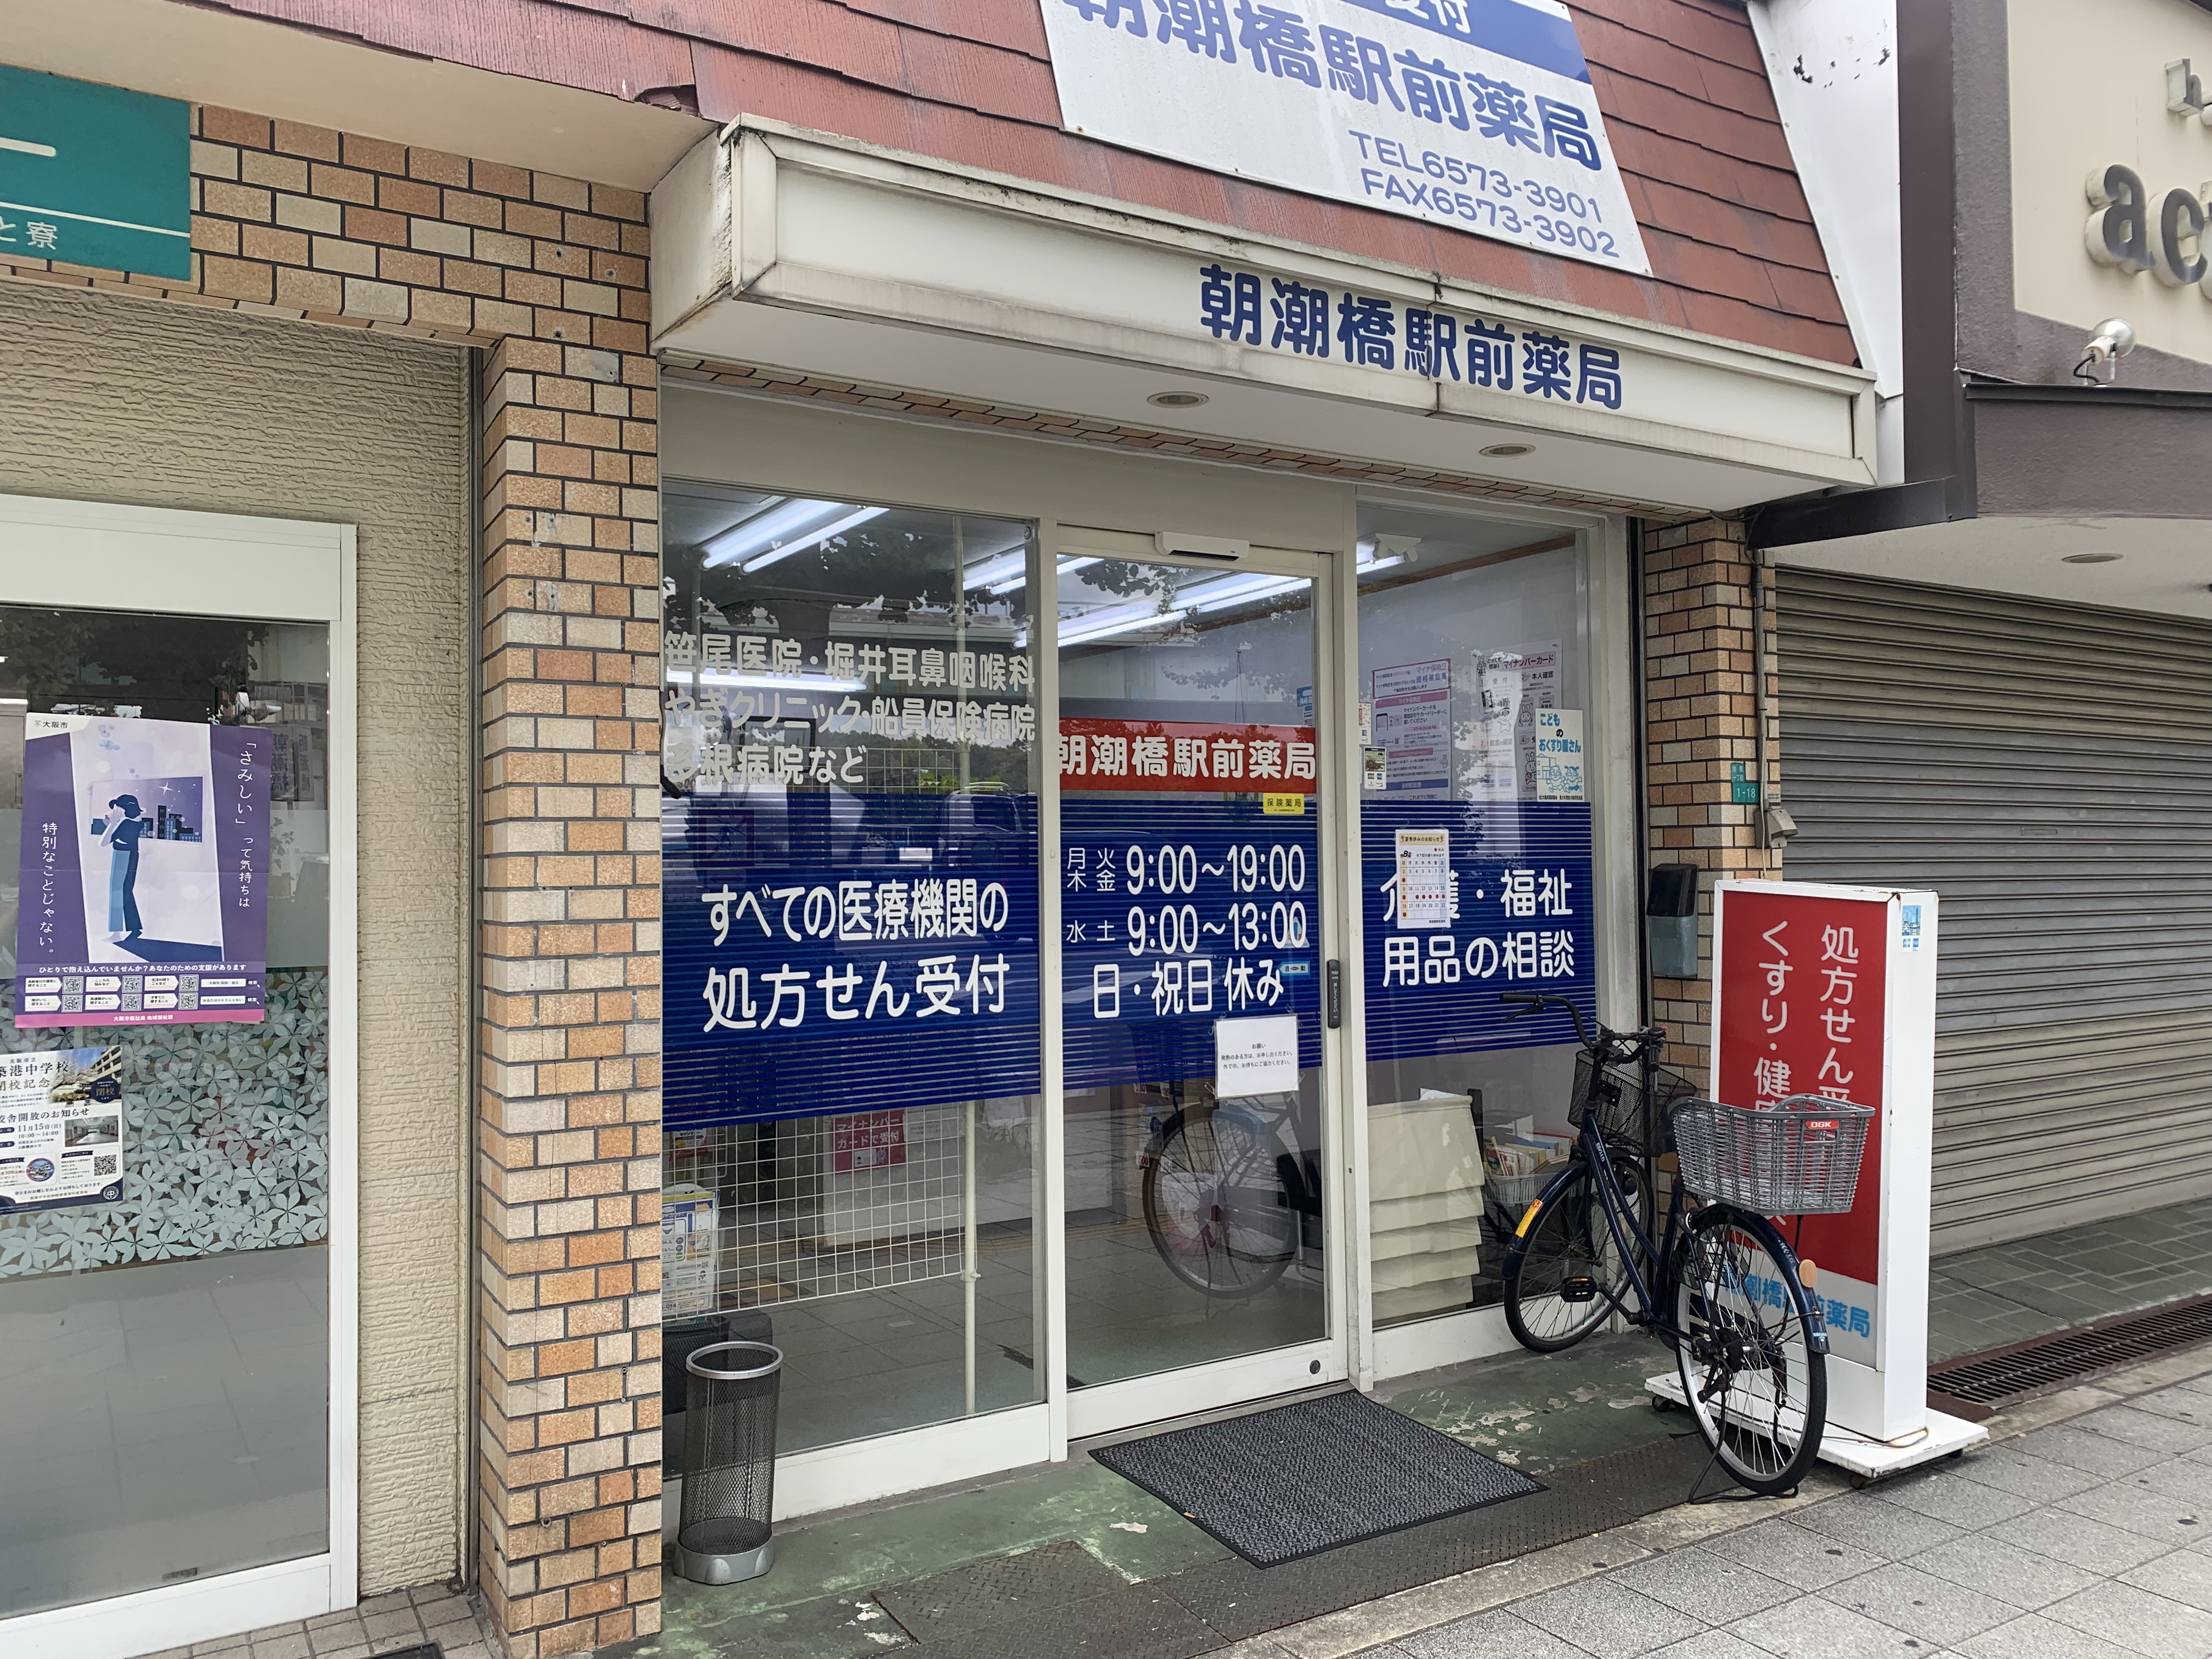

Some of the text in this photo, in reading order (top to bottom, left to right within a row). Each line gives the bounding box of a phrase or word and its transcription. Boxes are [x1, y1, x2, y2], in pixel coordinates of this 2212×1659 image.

[1349, 129, 1601, 223] TEL6573-3901
[1361, 168, 1620, 258] FAX6573-3902
[2086, 163, 2212, 299] ac
[1199, 264, 1623, 410] 朝潮橋駅前薬局
[1504, 654, 1554, 669] マイナンバーカード
[42, 720, 68, 729] 大阪市
[1540, 713, 1560, 726] こども
[1556, 729, 1564, 737] の
[665, 744, 867, 786] 多根病院など
[1059, 732, 1316, 780] 朝潮橋駅前薬局
[1539, 739, 1581, 753] おくすり屋さん
[1267, 798, 1301, 807] 保険薬局
[1737, 787, 1756, 798] 1-18
[1067, 848, 1115, 870] 月 火
[39, 822, 58, 954] 特別なことじゃない。
[1066, 870, 1116, 892] 木 金
[701, 878, 1009, 946] すべての医療機関の
[1066, 920, 1115, 943] 水 土
[1383, 930, 1575, 988] 用品の相談
[702, 953, 1010, 1032] 処方せん受付
[1093, 956, 1284, 1019] 日・祝日休み
[1753, 921, 1793, 1111] くすり・健
[1596, 1142, 1605, 1163] BROAD
